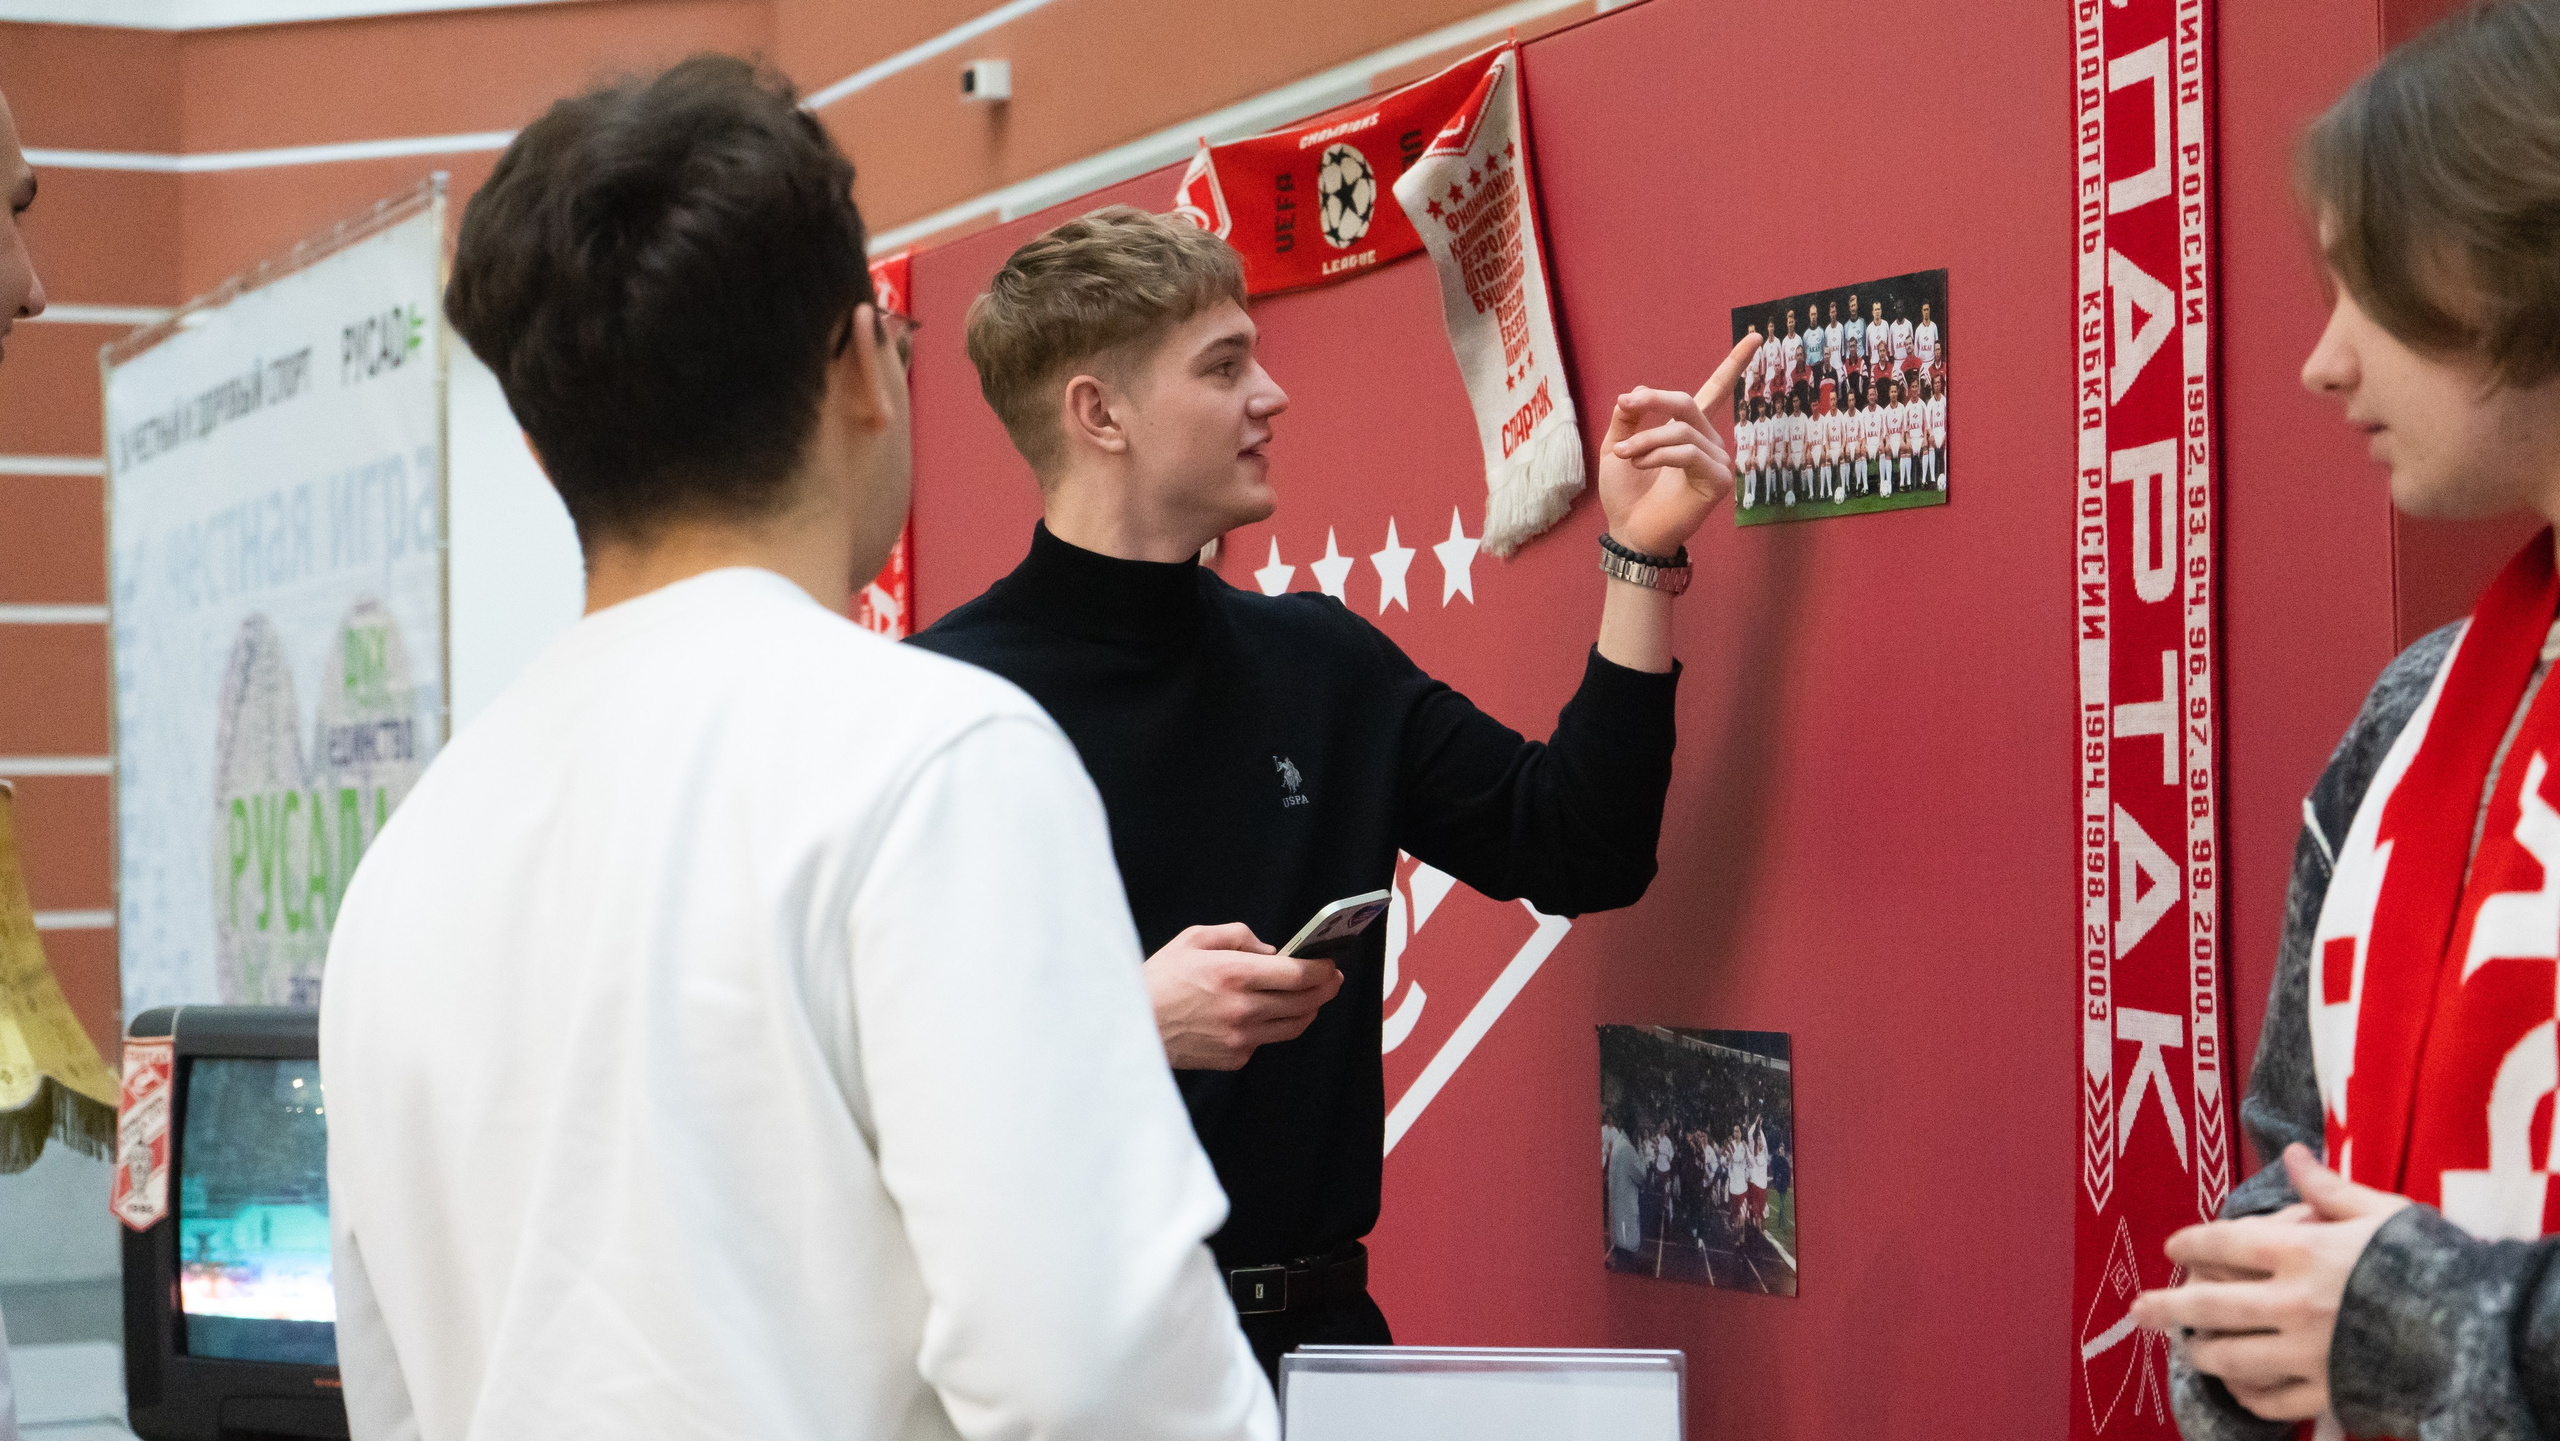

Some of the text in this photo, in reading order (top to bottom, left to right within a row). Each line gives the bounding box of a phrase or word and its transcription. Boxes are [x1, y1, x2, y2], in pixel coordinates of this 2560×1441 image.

[1299, 112, 1381, 150] CHAMPIONS
[1275, 172, 1295, 254] UEFA
[2182, 142, 2203, 326] РОССИИ
[1321, 249, 1377, 276] LEAGUE
[2082, 291, 2102, 431] КУБКА
[1502, 375, 1554, 461] СПАРТАК
[2081, 467, 2106, 641] РОССИИ
[2108, 0, 2188, 1174] ПАРТАК
[1282, 794, 1309, 808] USPA
[2087, 924, 2108, 1021] 2003
